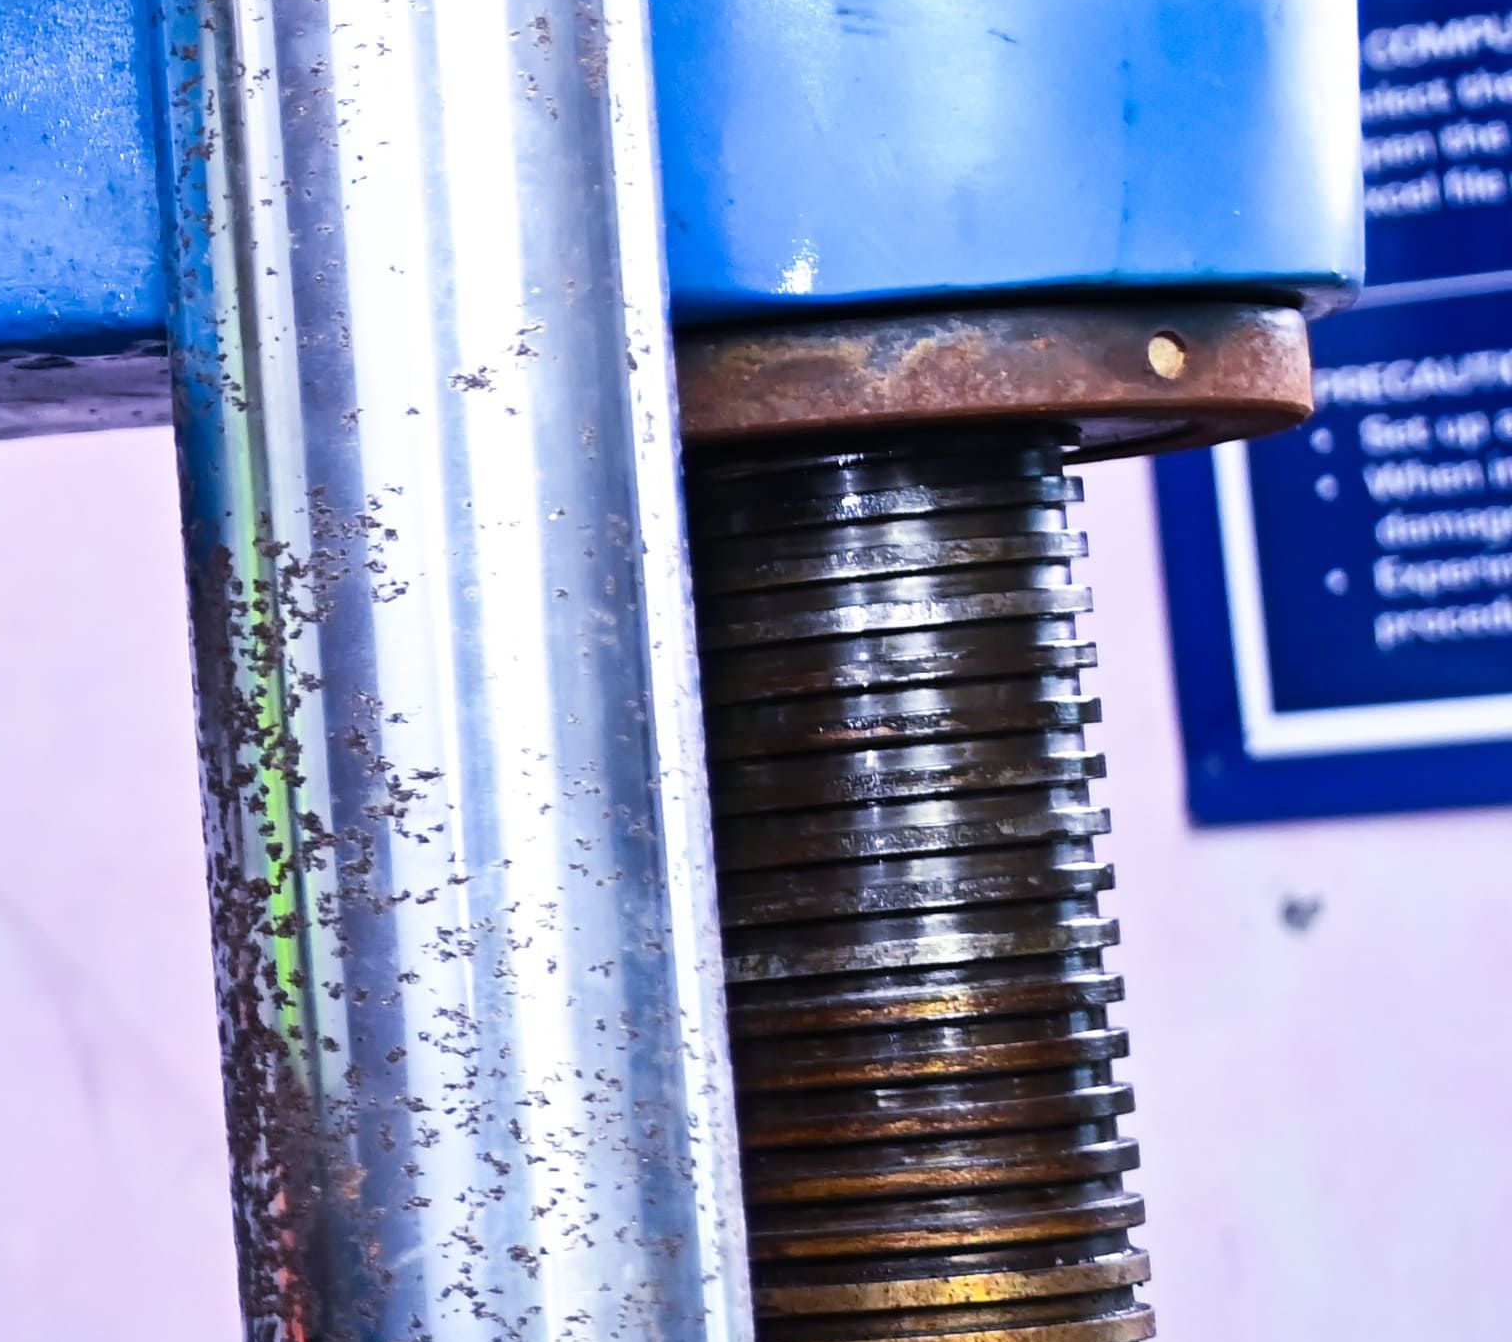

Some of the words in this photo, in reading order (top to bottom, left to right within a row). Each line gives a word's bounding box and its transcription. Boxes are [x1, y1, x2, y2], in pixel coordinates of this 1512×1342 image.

[1363, 130, 1438, 174] pen
[1439, 119, 1511, 159] the
[1360, 413, 1432, 455] Set
[1364, 458, 1485, 501] When
